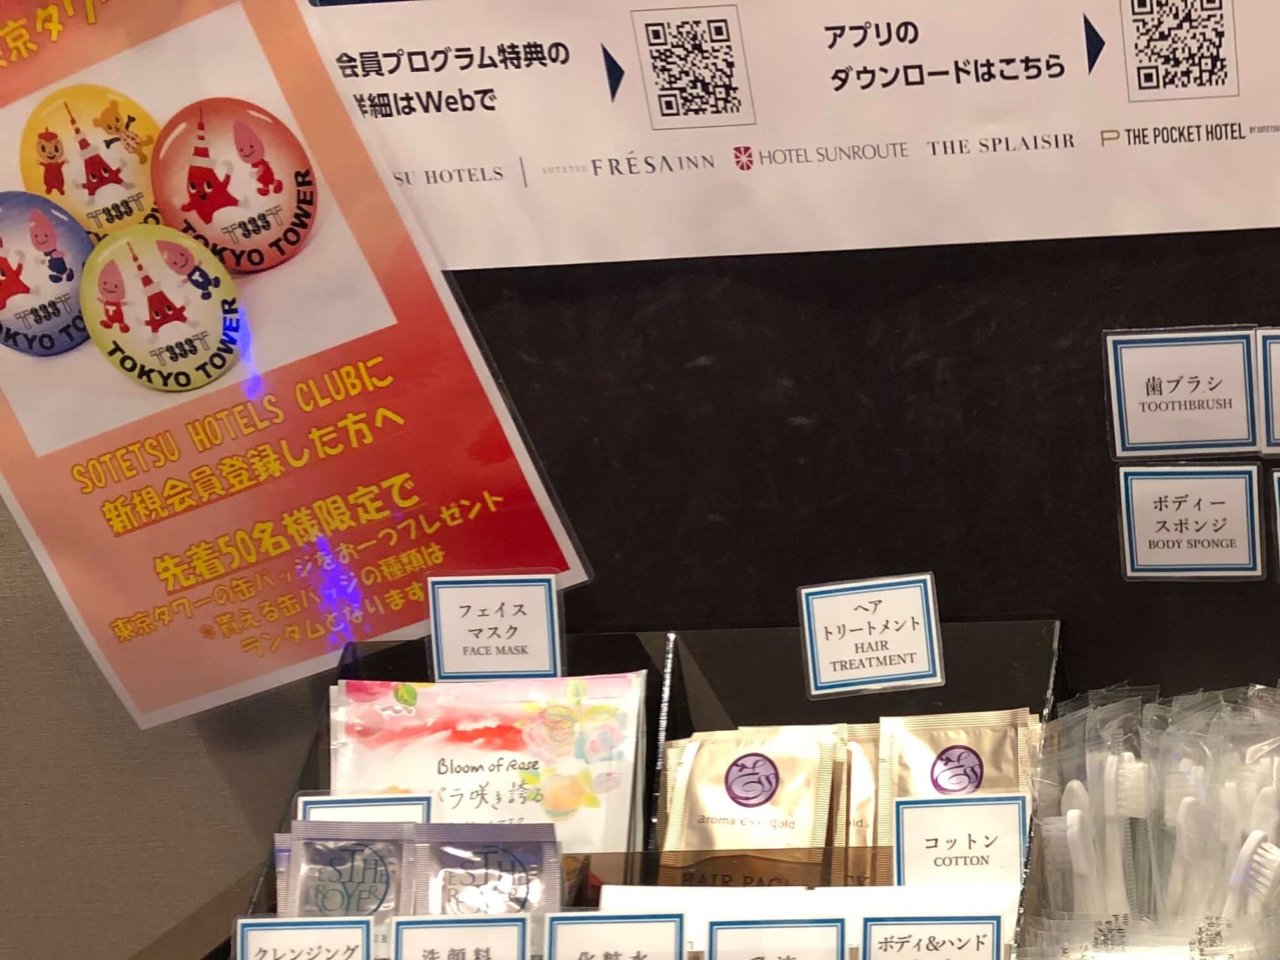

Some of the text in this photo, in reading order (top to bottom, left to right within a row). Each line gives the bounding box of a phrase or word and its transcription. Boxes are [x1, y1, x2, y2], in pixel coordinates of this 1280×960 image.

[824, 20, 920, 49] アプリの
[335, 40, 570, 79] 会員プログラム特典の
[830, 54, 1066, 92] ダウンロードはこちら
[1125, 122, 1246, 146] THE POCKET HOTEL
[758, 141, 910, 165] HOTEL SUNROUTE
[927, 132, 1076, 157] THE SPLAISIR
[678, 153, 716, 170] INN
[425, 166, 505, 186] HOTELS
[269, 168, 317, 257] TOWER
[106, 296, 239, 389] TOKYO TOWER
[1144, 375, 1224, 397] 歯ブラシ
[1139, 397, 1233, 412] TOOTHBRUSH
[72, 355, 396, 495] SOTETSU HOTELS CLUBに
[101, 405, 407, 536] 新規会員登録した方へ
[1152, 495, 1227, 514] ボディー
[153, 472, 420, 594] 先着50名様限定で
[1154, 516, 1228, 535] スポンジ
[1147, 538, 1238, 551] BODY SPONGE
[457, 601, 528, 619] フェイス
[853, 599, 882, 615] ヘア
[467, 624, 519, 641] マスク
[824, 616, 920, 641] トリートメント
[462, 644, 529, 657] FACE MASK
[854, 639, 889, 654] HAIR
[829, 652, 917, 672] TREATMENT
[437, 759, 484, 775] Bloom
[488, 758, 505, 773] of
[924, 833, 999, 851] コットン
[933, 855, 990, 868] COTTON
